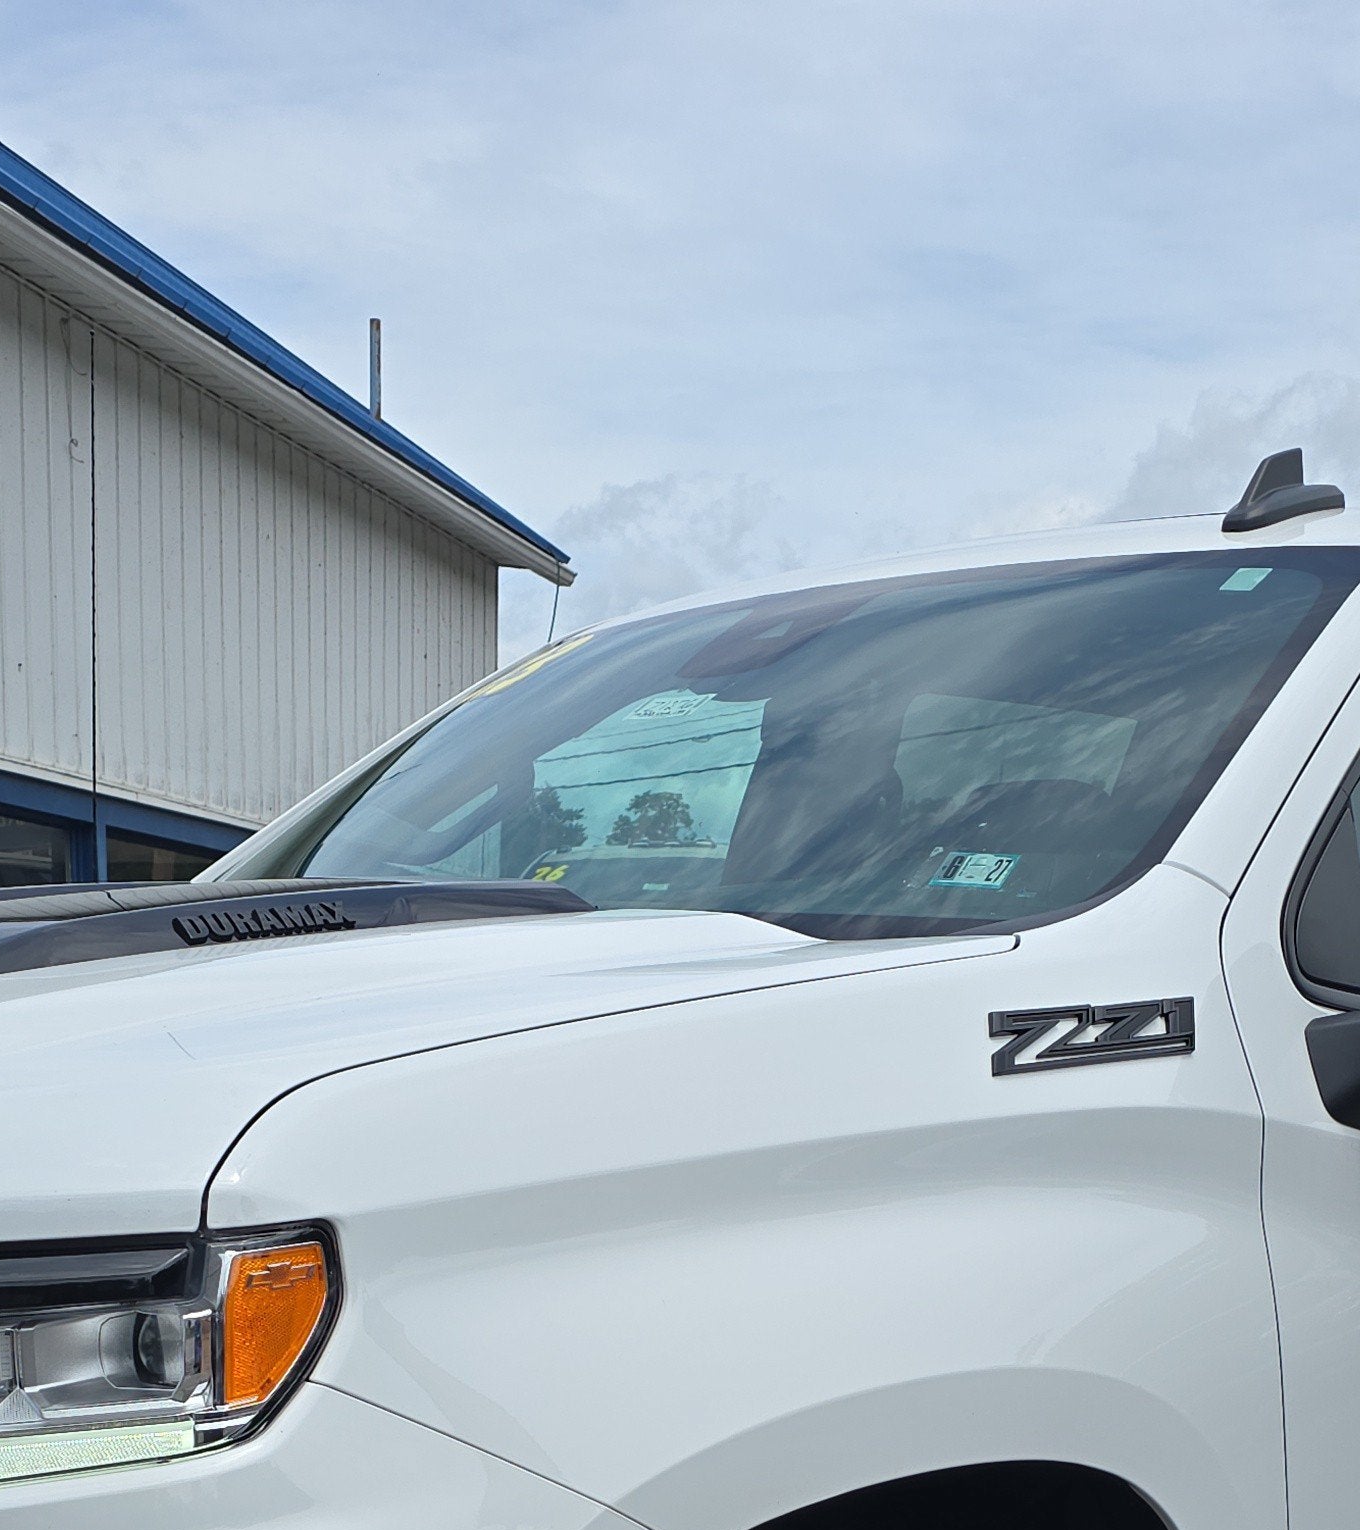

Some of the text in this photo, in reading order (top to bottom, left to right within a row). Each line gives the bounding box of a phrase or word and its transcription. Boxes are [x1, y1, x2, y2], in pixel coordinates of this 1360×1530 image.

[533, 865, 570, 882] 26
[984, 859, 1014, 883] 27
[172, 900, 357, 946] DURAMAX
[988, 995, 1195, 1077] Z71
